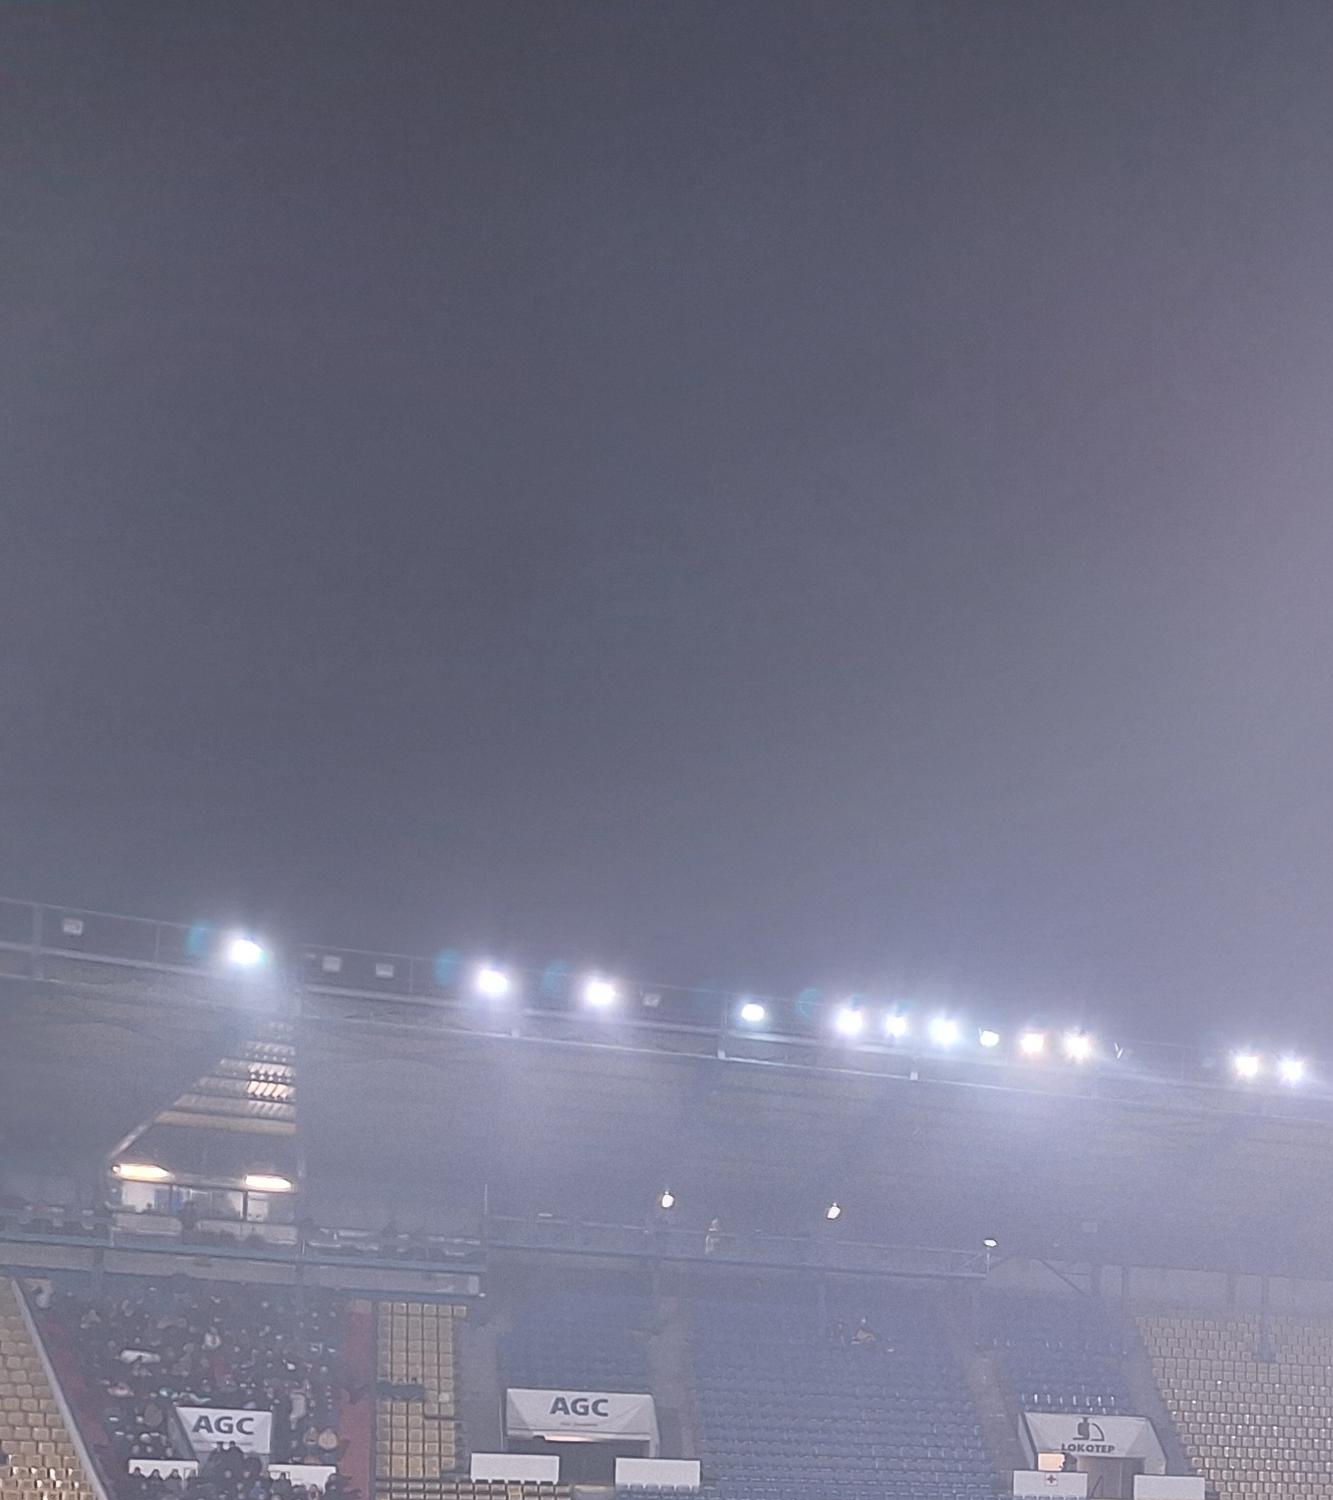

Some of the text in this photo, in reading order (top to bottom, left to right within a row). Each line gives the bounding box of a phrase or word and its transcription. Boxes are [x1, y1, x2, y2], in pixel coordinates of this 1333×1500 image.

[550, 1397, 608, 1417] AGC
[192, 1415, 254, 1435] AGC
[1061, 1443, 1115, 1453] LOKOTEP
